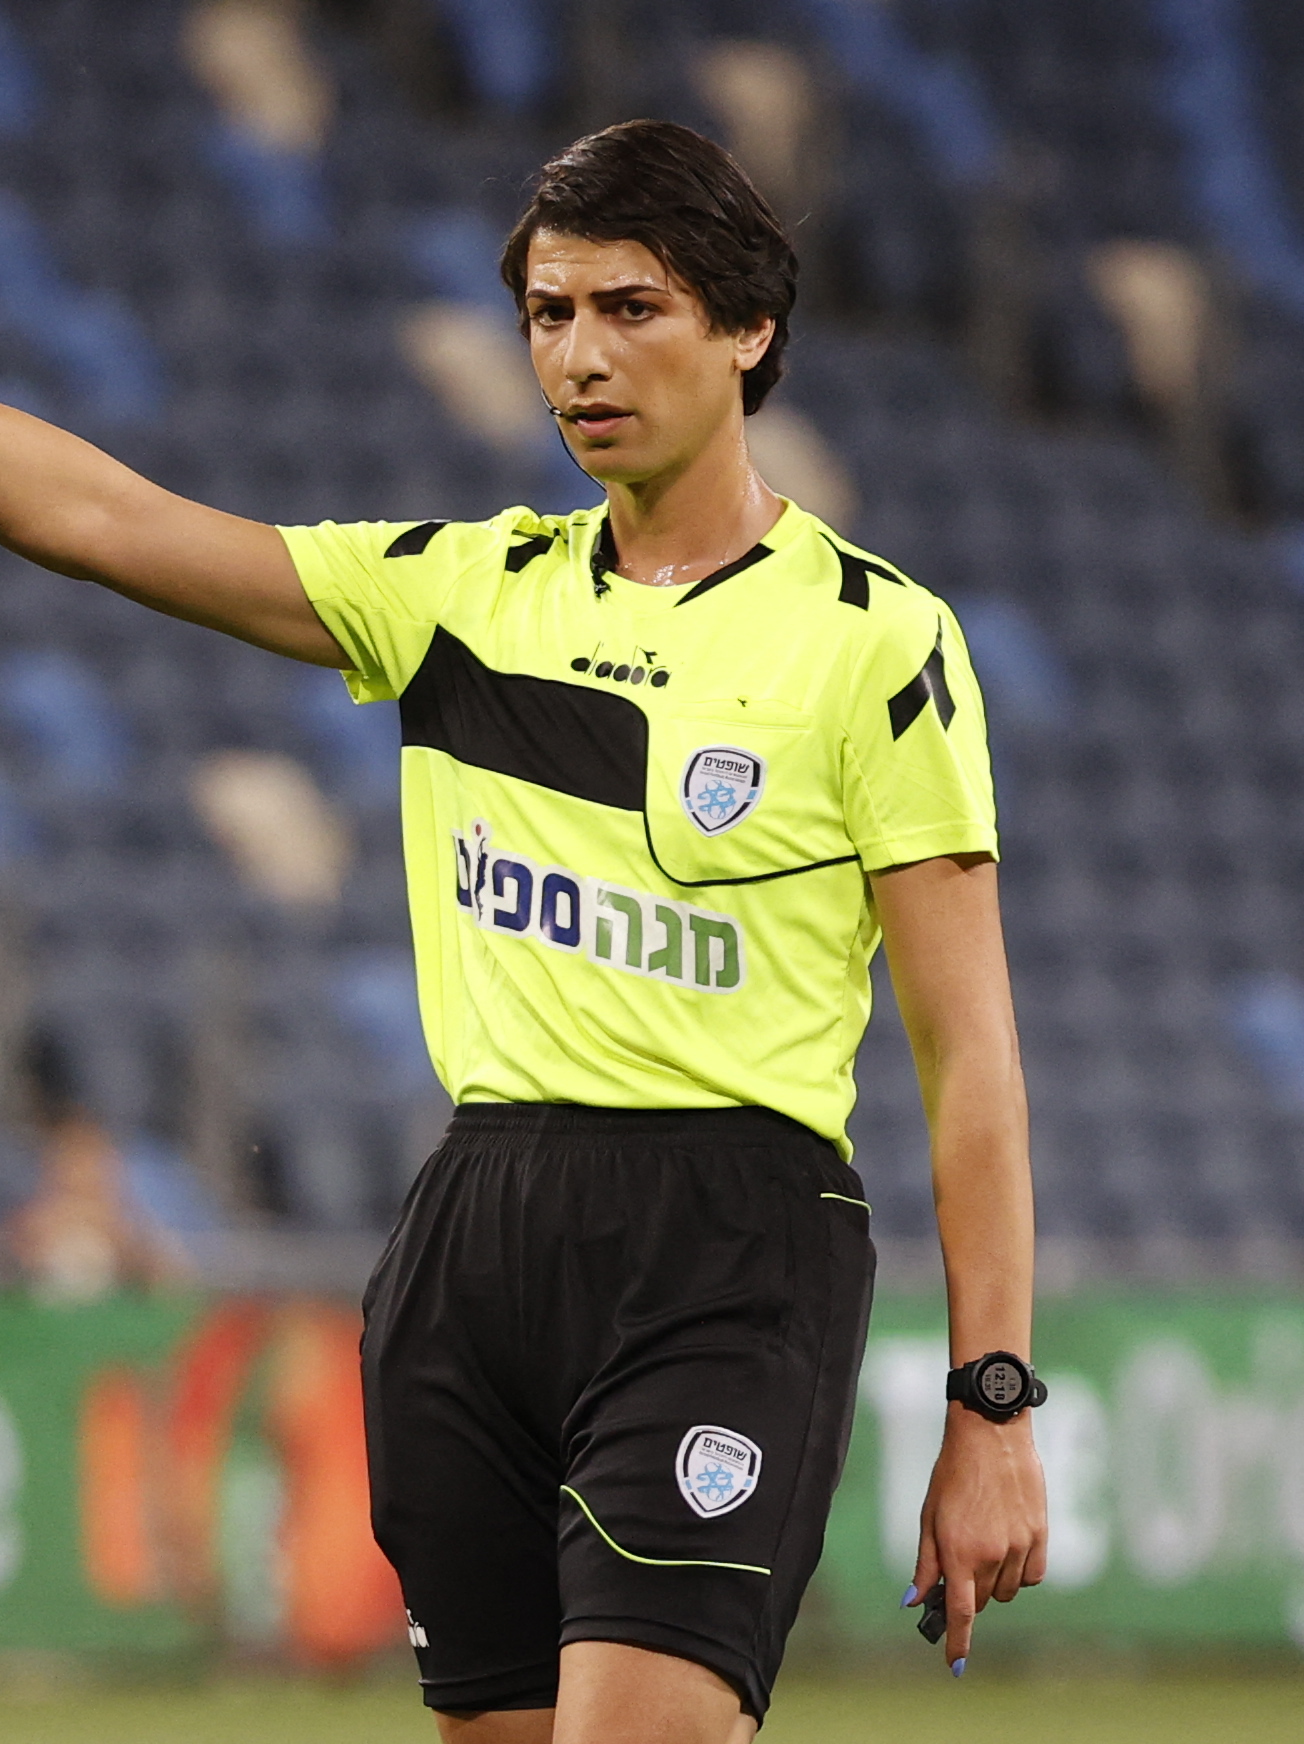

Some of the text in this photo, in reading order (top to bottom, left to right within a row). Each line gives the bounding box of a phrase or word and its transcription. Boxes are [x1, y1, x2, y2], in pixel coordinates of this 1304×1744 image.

[570, 640, 672, 689] diadora
[704, 756, 750, 774] שופטים
[596, 887, 741, 989] מגה
[703, 1437, 748, 1461] שופטים
